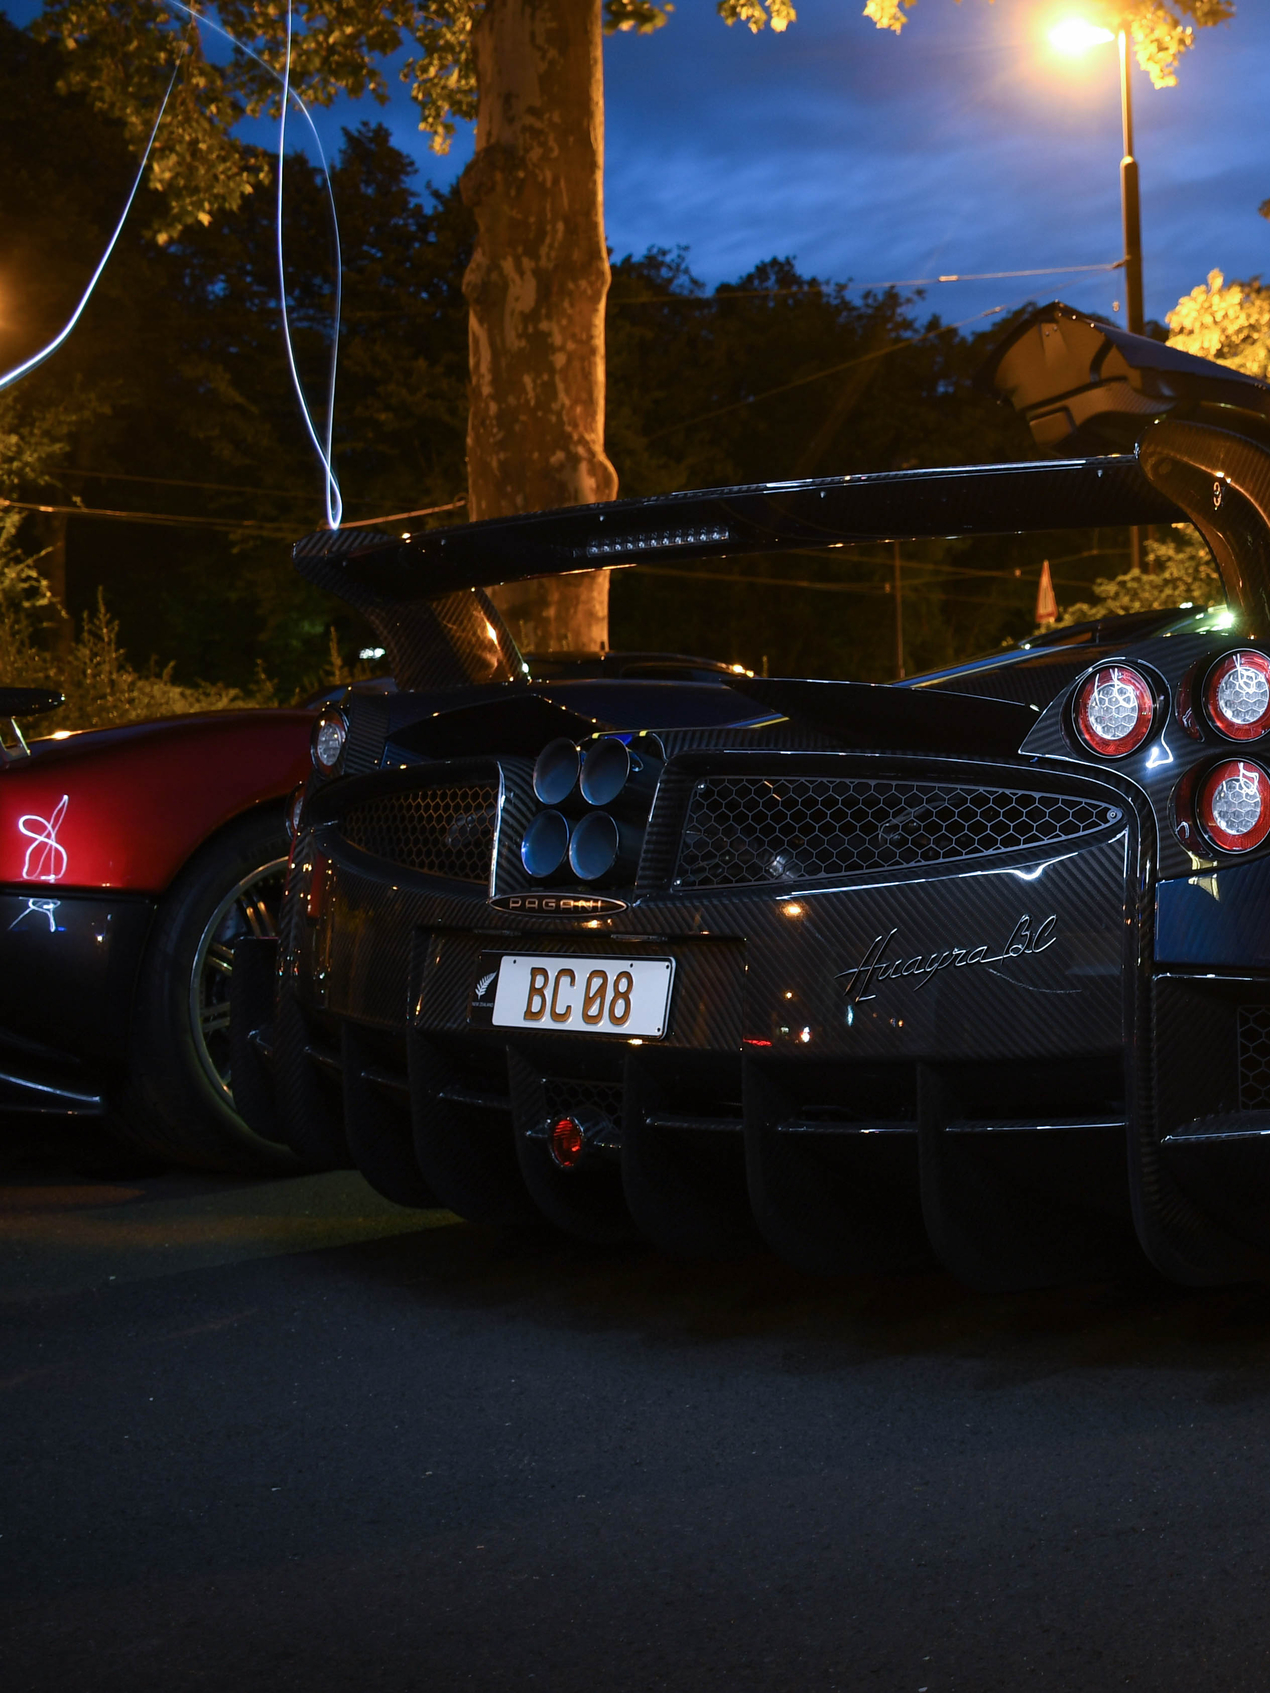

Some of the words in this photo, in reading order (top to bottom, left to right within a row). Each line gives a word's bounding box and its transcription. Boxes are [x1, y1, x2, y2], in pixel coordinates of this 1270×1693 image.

[509, 898, 602, 912] PAGANI
[834, 927, 990, 1003] Huayra
[1000, 913, 1058, 965] BC
